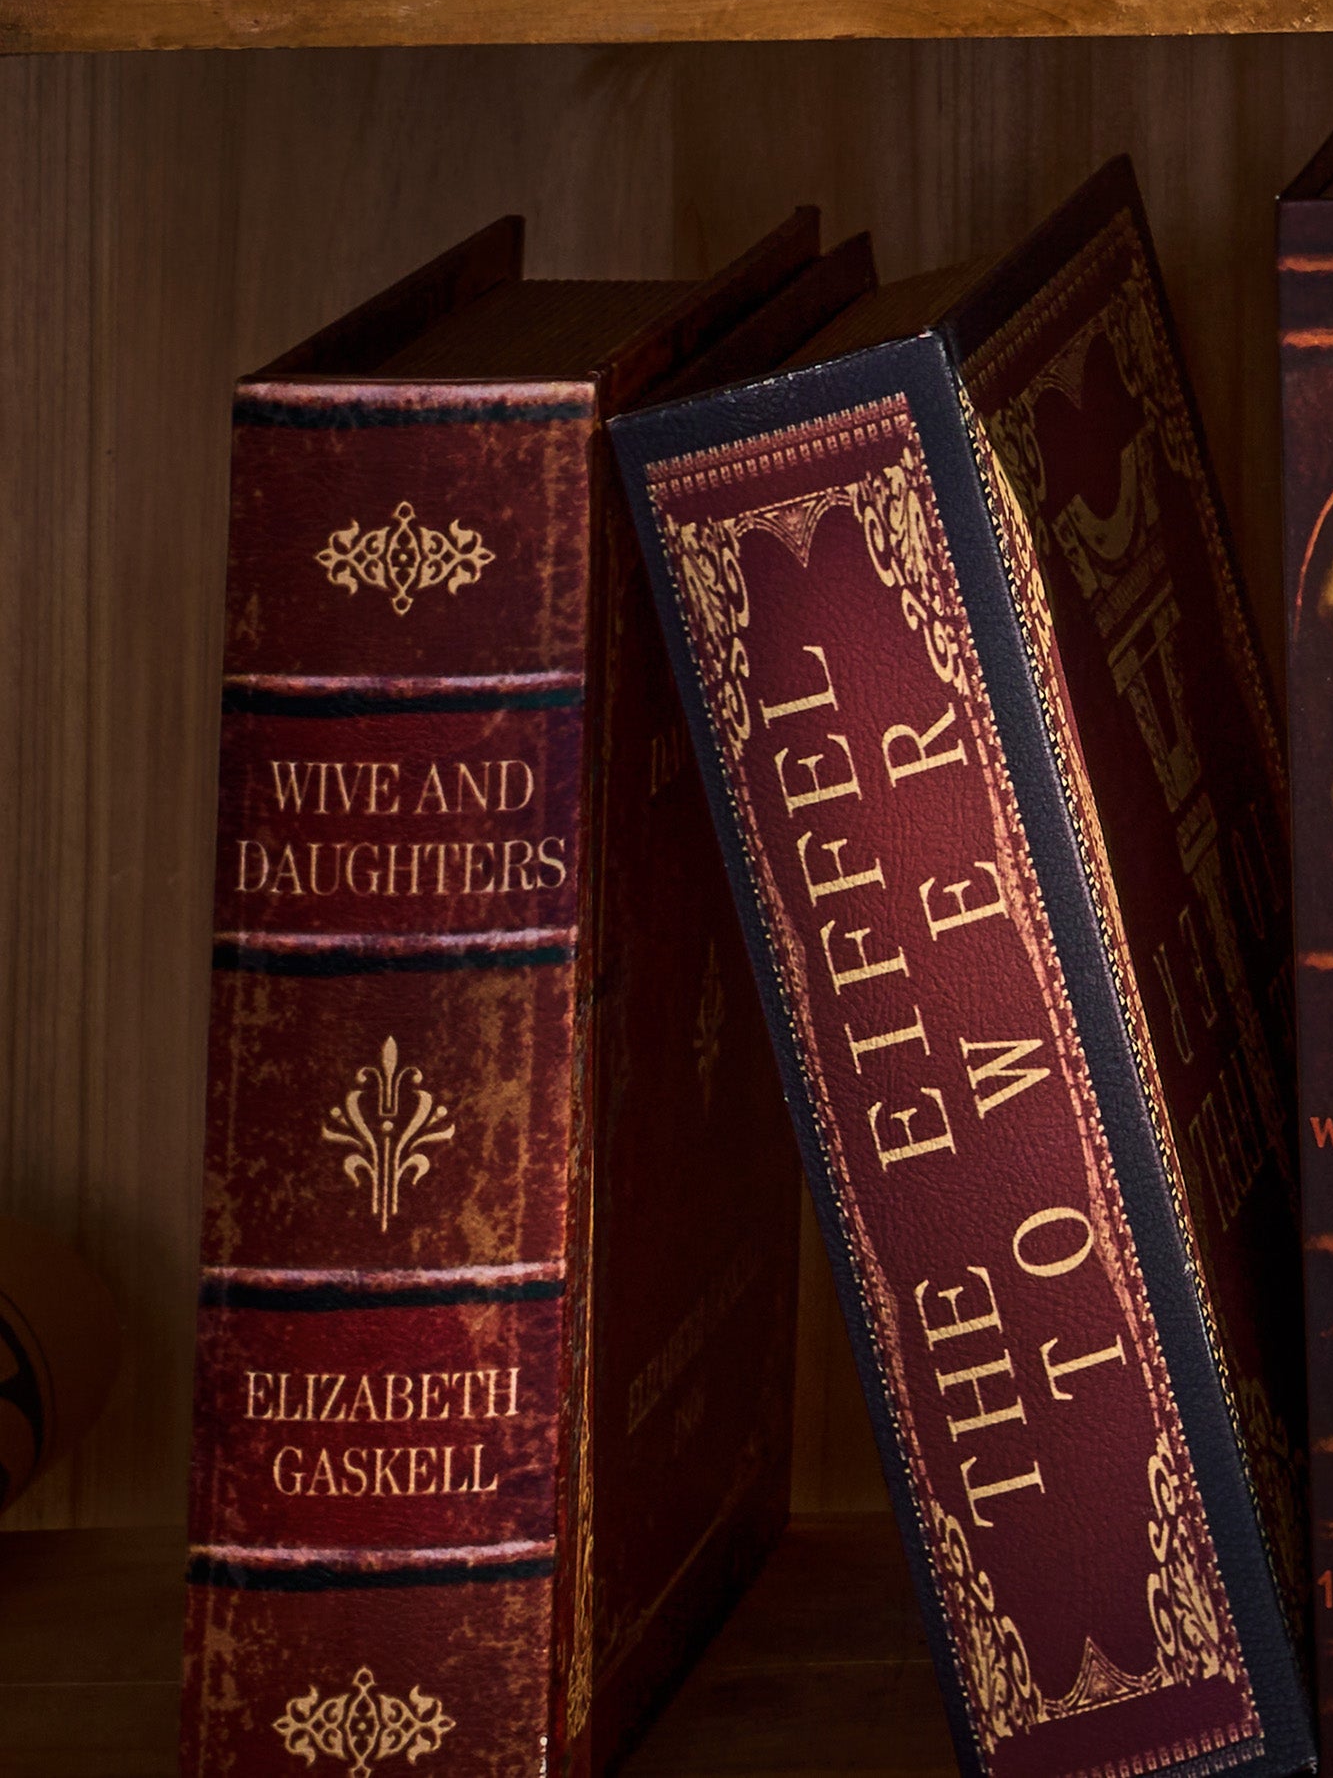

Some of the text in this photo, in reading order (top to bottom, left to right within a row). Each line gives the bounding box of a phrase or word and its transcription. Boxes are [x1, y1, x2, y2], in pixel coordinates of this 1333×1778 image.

[269, 758, 536, 817] WIVE AND
[235, 835, 568, 898] DAUGHTERS
[881, 702, 1127, 1401] TOWER
[762, 644, 1047, 1529] THE EIFFEL
[243, 1366, 522, 1423] ELIZABETH
[271, 1443, 500, 1498] GASKELL
